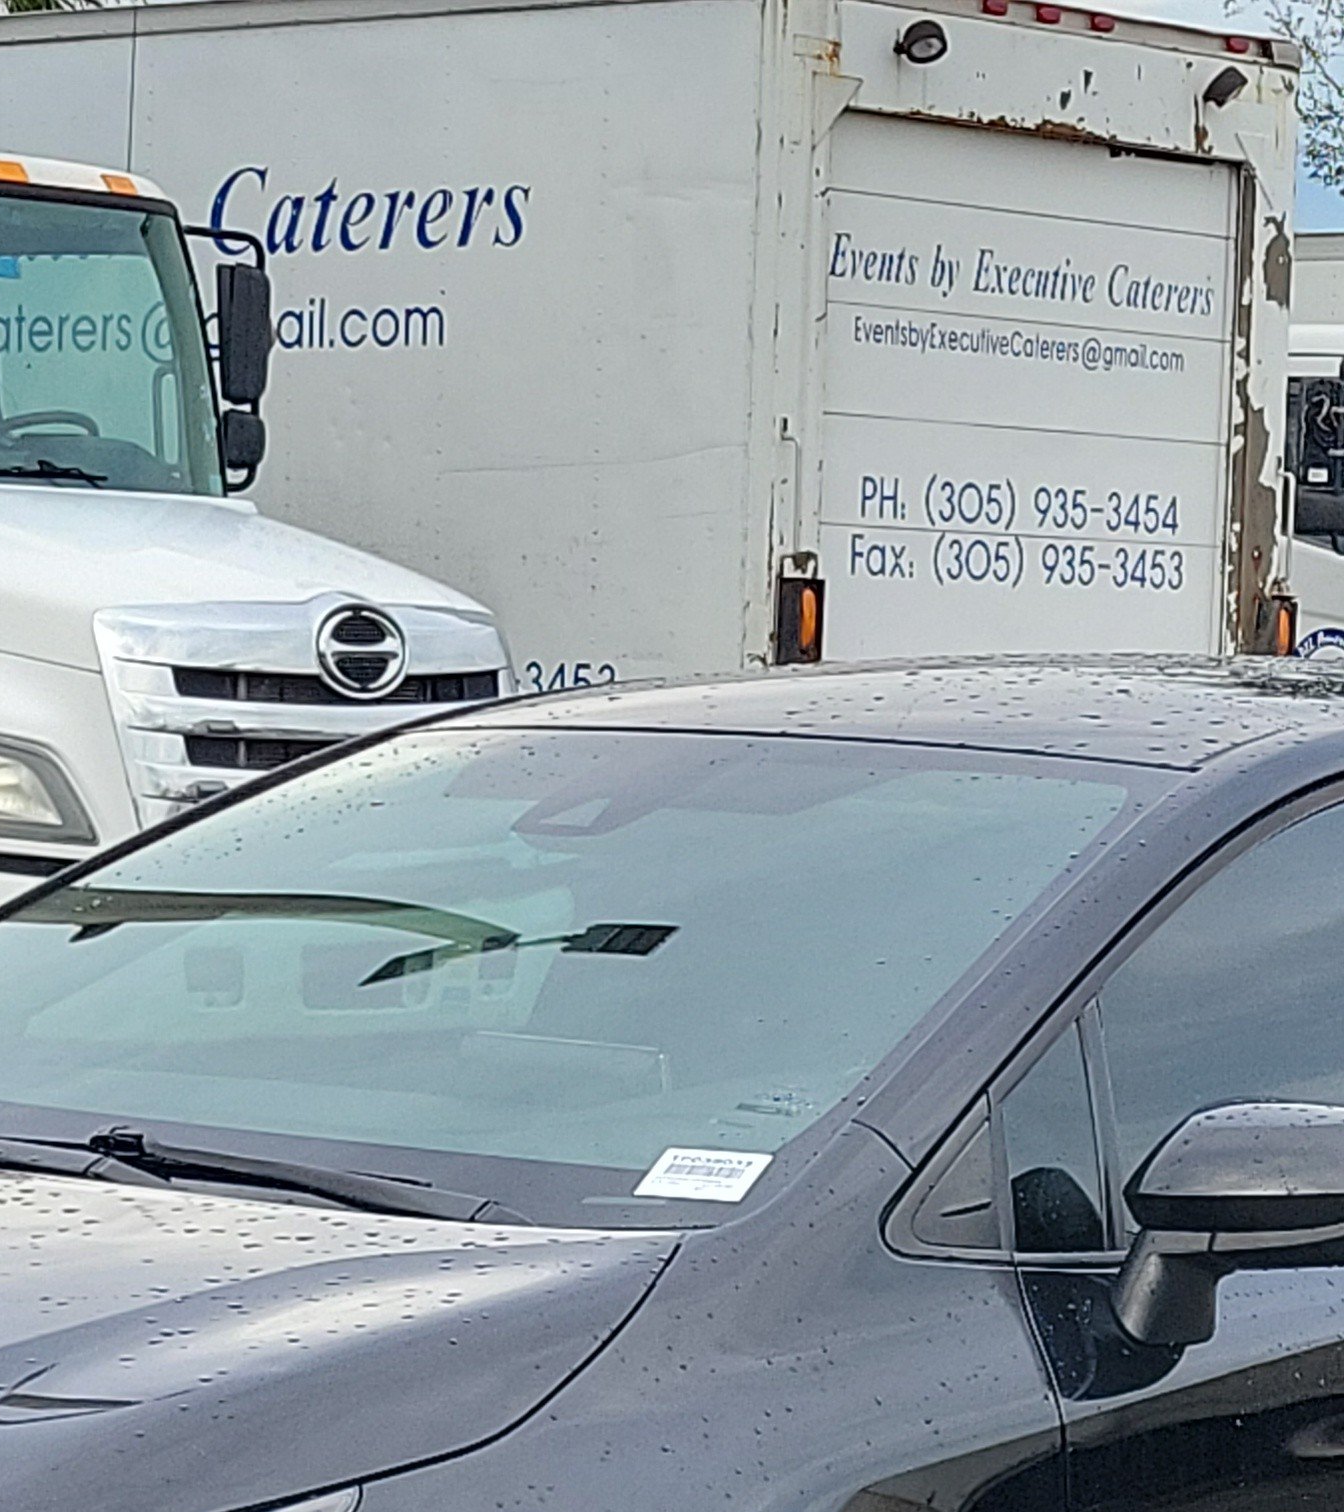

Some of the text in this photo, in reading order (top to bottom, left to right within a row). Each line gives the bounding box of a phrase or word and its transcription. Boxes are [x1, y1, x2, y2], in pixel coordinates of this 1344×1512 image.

[210, 166, 531, 255] Caterers
[828, 231, 1215, 316] Events by Executive Caterers
[853, 315, 1185, 372] EventsbyExecutiveCaterers@gmail.com
[860, 474, 1180, 535] PH: (305) 935-3454
[849, 531, 1184, 590] Fax: (305) 935-3453
